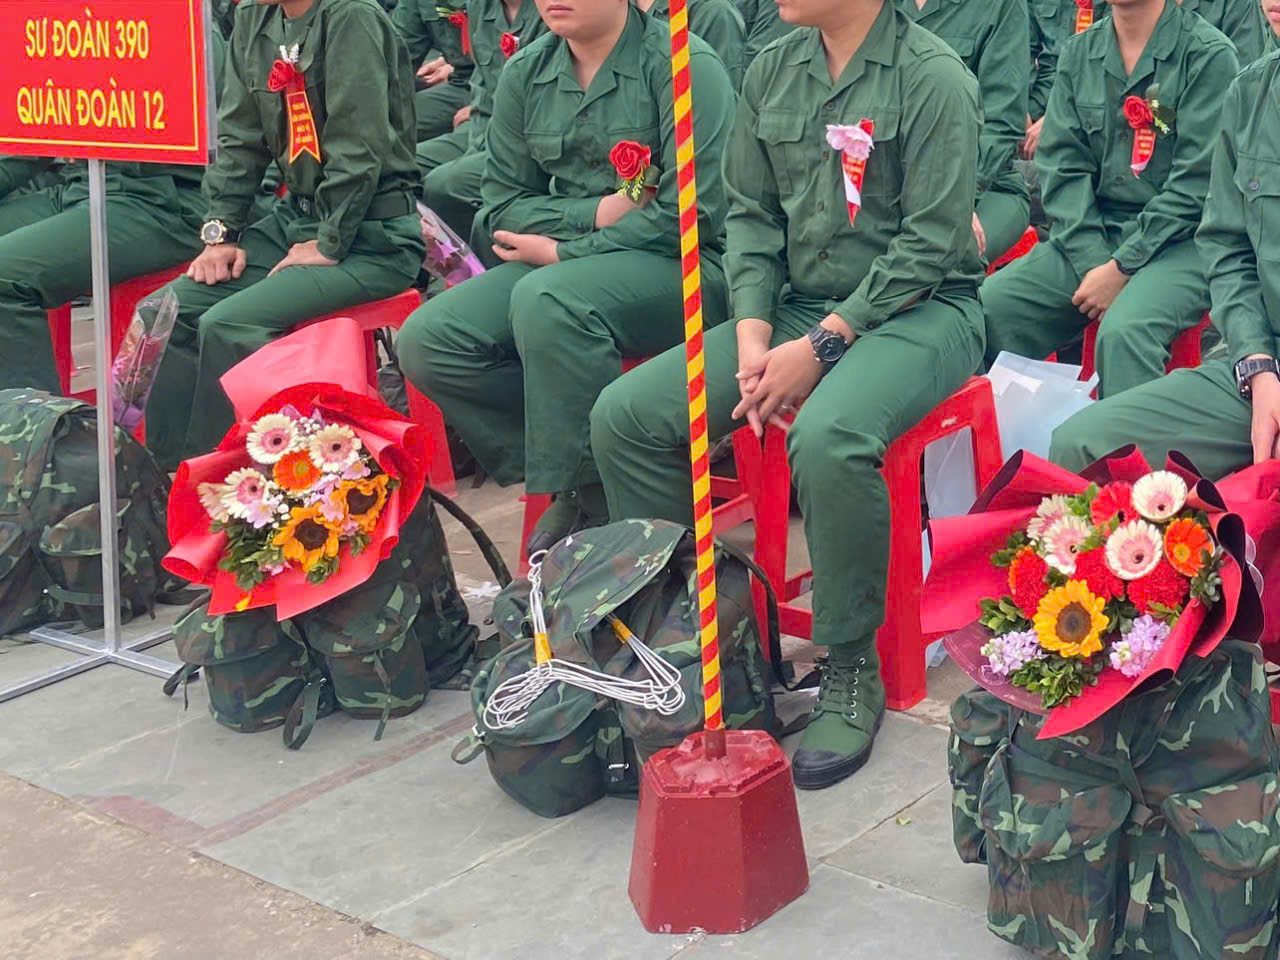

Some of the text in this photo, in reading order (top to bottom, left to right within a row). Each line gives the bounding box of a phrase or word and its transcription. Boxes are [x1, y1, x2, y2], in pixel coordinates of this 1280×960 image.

[52, 7, 110, 58] ĐOÀN
[115, 19, 150, 59] 390
[16, 77, 165, 130] QUÂN ĐOÀN 12
